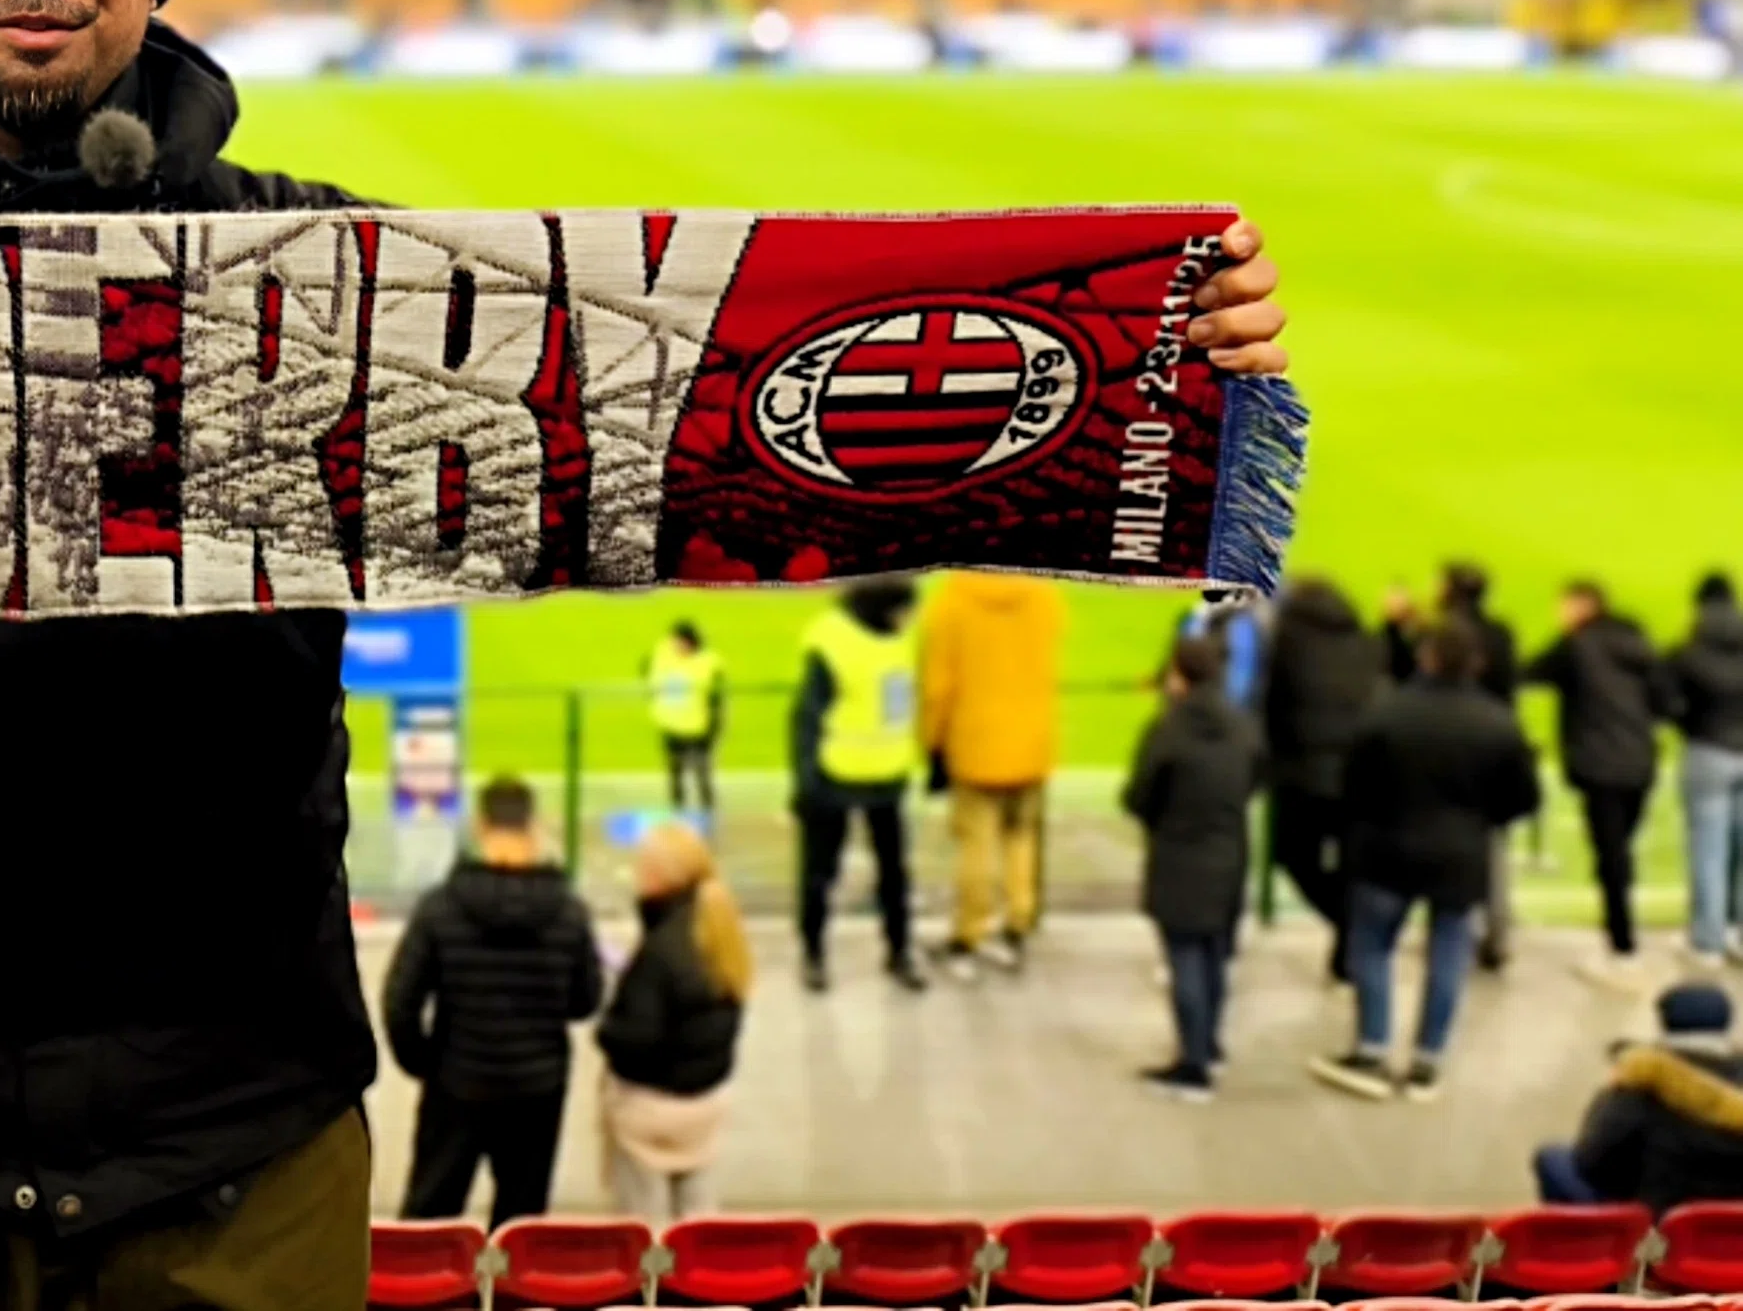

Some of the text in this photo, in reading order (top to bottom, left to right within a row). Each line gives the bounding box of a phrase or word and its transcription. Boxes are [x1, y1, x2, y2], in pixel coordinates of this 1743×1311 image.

[763, 338, 845, 466] ACM
[1008, 349, 1066, 446] 1899
[1109, 421, 1174, 563] MILANO
